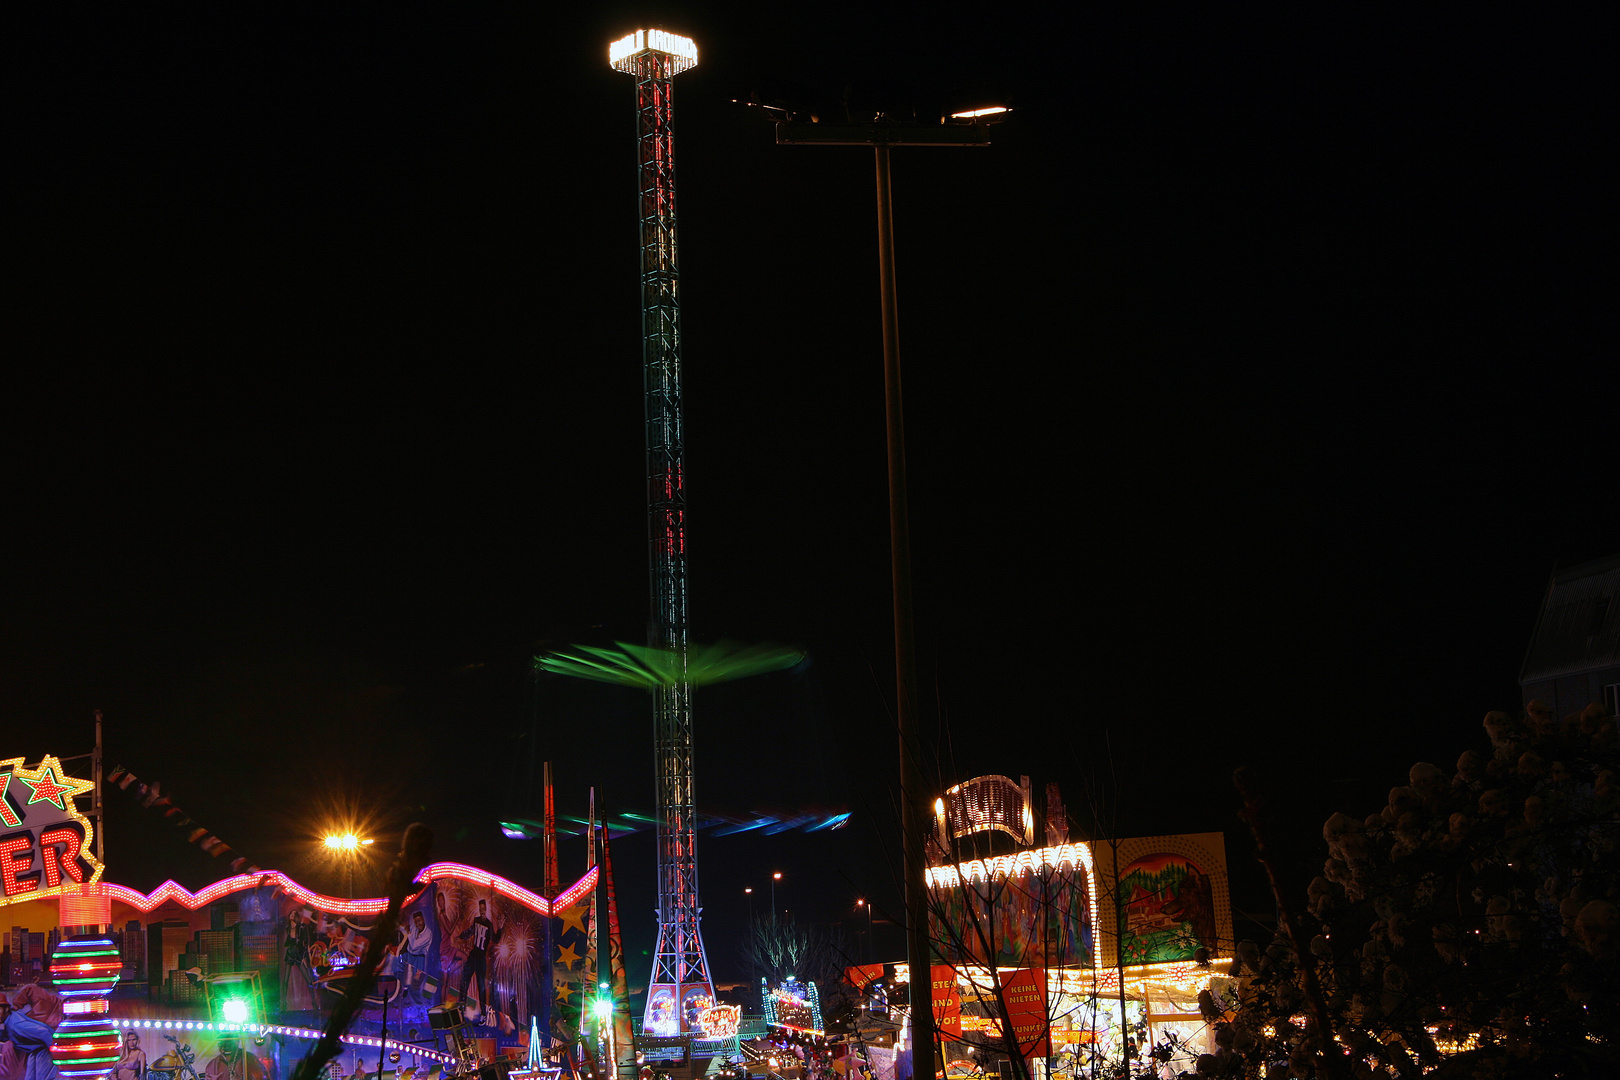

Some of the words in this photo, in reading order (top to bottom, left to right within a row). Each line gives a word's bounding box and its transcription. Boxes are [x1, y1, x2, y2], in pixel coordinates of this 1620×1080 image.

[932, 980, 957, 990] ETEN
[1010, 984, 1037, 994] KEINE
[1009, 995, 1040, 1004] NIETEN
